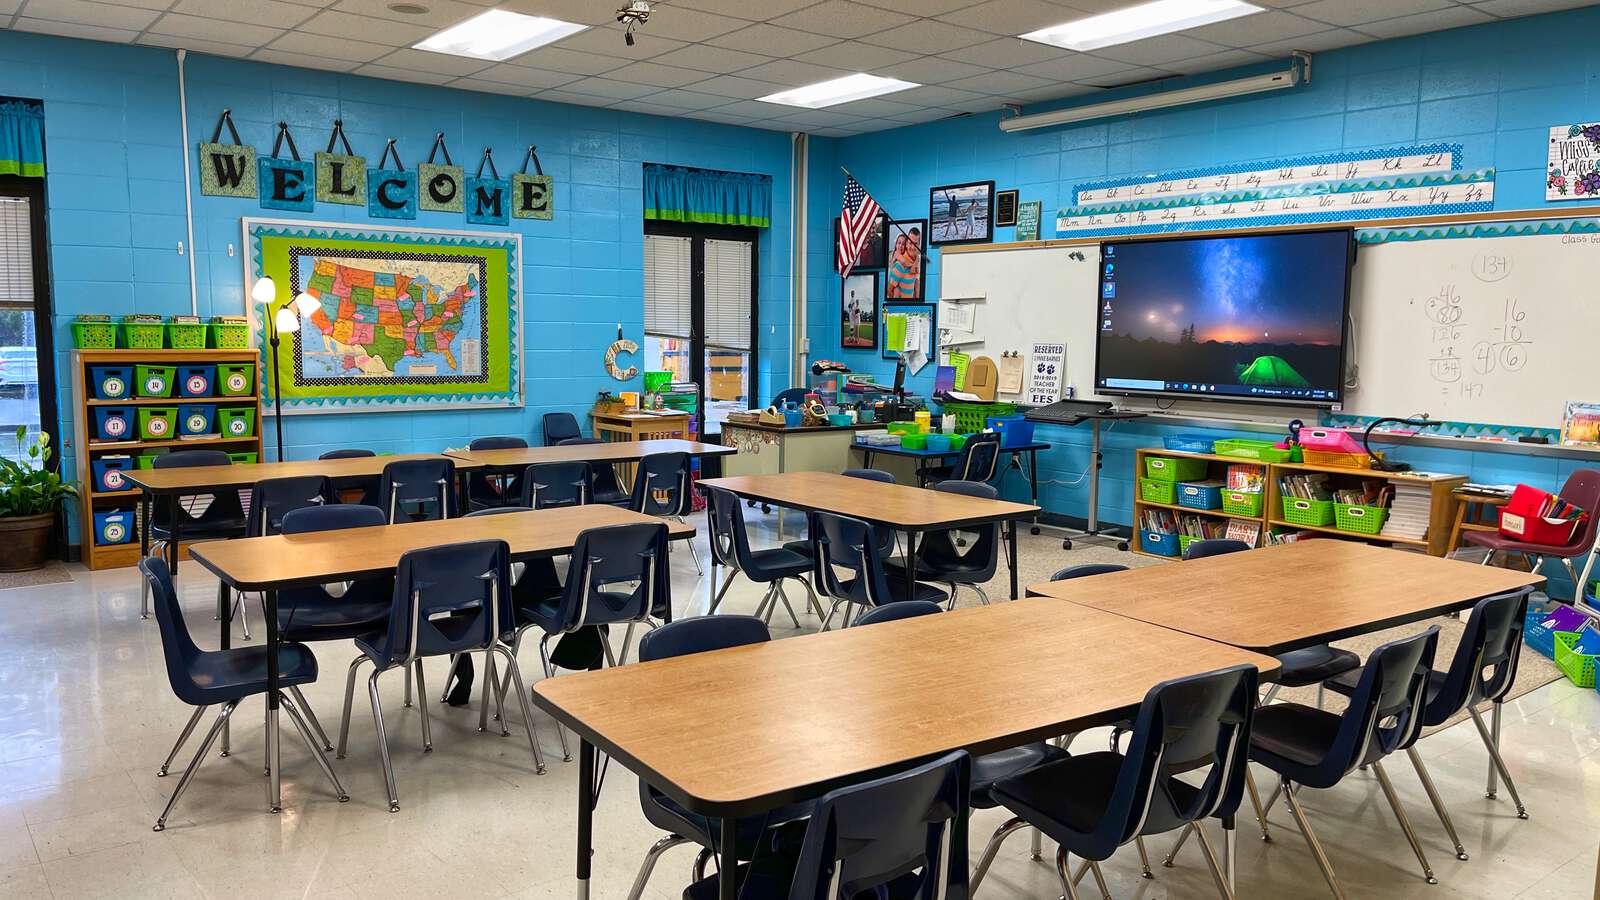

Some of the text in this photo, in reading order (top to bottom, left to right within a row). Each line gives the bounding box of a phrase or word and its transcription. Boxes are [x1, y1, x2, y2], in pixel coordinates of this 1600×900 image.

[210, 152, 547, 218] WELCOME
[1081, 192, 1092, 201] Aa
[1134, 186, 1144, 195] Cc
[1157, 182, 1172, 192] Dd
[1187, 180, 1198, 190] Ee
[1216, 176, 1228, 191] Ff
[1345, 163, 1358, 180] Jj
[1382, 158, 1402, 171] Kk
[1422, 154, 1442, 167] Ll
[1061, 218, 1080, 227] Mm
[1088, 215, 1102, 224] Nn
[1114, 213, 1126, 223] Oo
[1136, 212, 1147, 225] Pp
[1192, 207, 1206, 216] Rr
[1222, 204, 1236, 214] Ss
[1282, 200, 1299, 210] Uu
[1320, 196, 1335, 207] Vv
[1352, 194, 1373, 205] Ww
[1386, 191, 1408, 202] Xx
[1428, 187, 1448, 203] Yy
[1464, 184, 1484, 201] Zz
[1562, 234, 1587, 244] Class
[1482, 255, 1506, 274] 134
[1505, 299, 1526, 322] 16
[1034, 345, 1063, 354] RESERVED
[1032, 394, 1053, 403] EES
